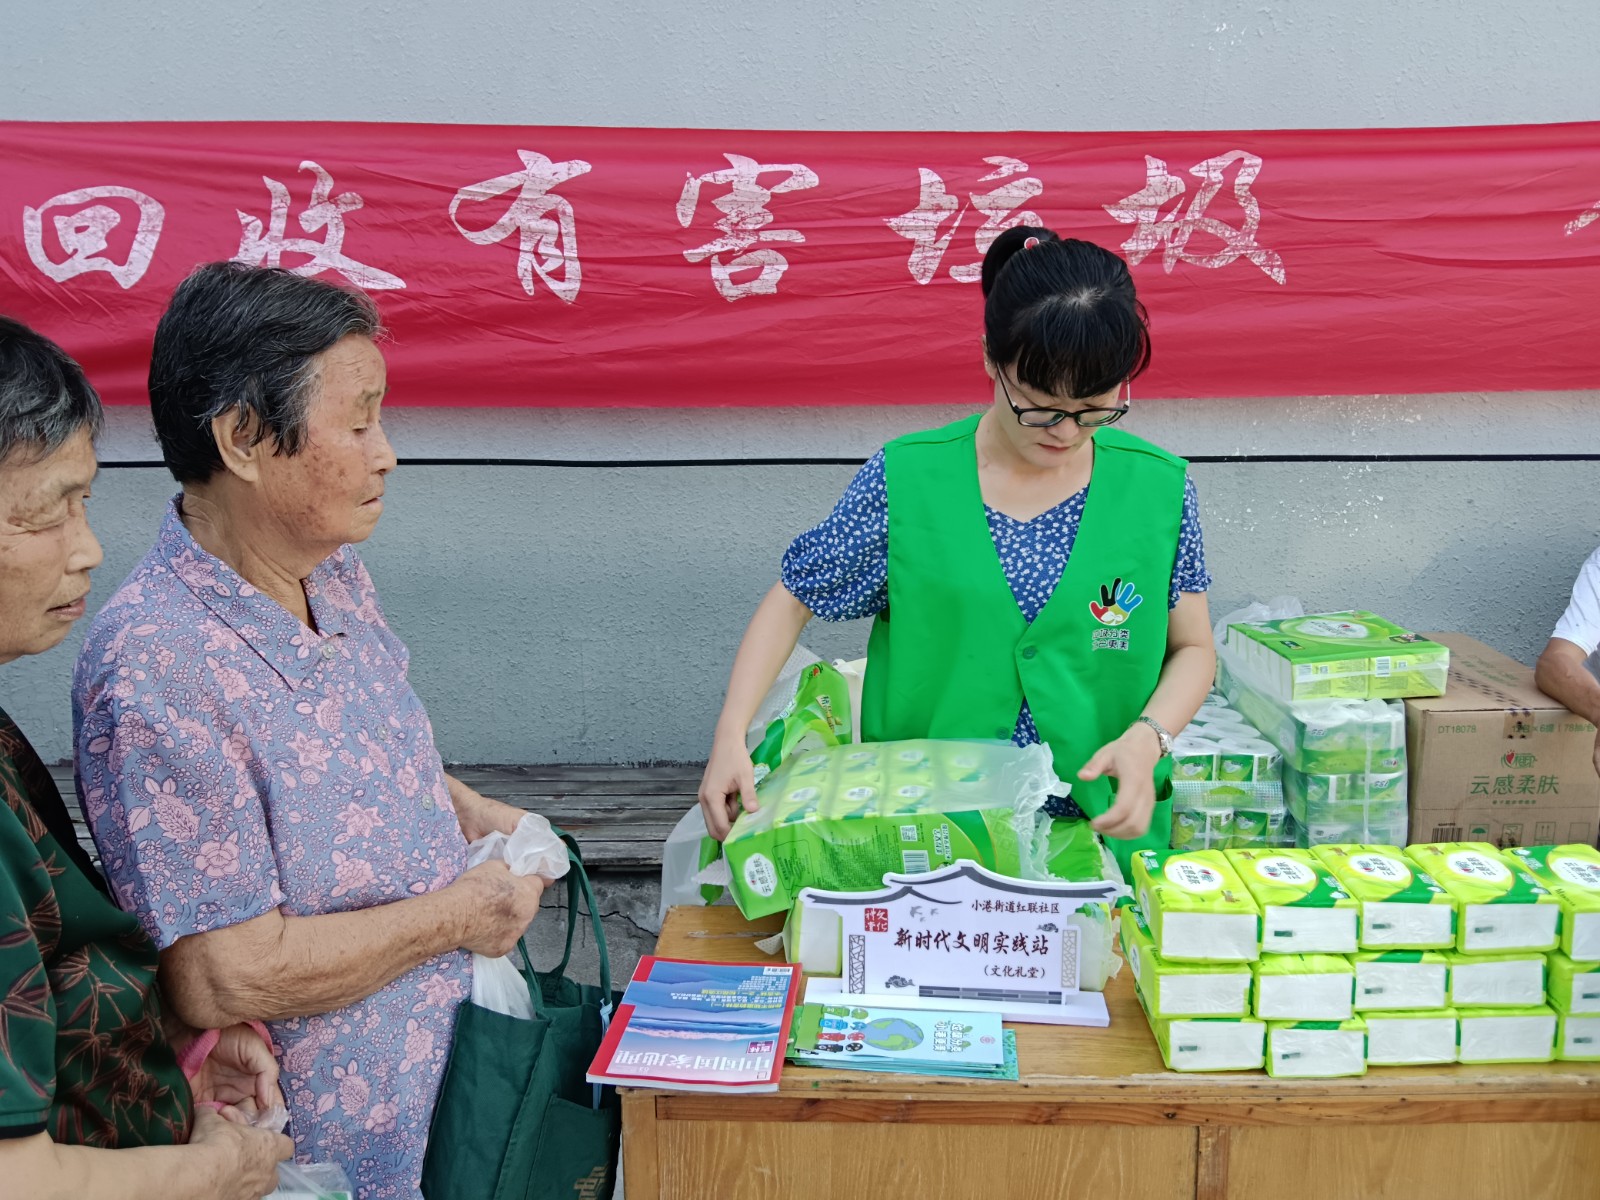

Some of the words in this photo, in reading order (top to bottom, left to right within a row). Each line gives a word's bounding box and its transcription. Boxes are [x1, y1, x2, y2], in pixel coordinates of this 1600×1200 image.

[1437, 725, 1477, 734] DT18078
[1470, 775, 1560, 795] 云感柔肤
[972, 900, 1060, 914] 小港街道红联社区
[894, 927, 1049, 956] 新时代文明实践站
[615, 1050, 771, 1072] 中国国家地理
